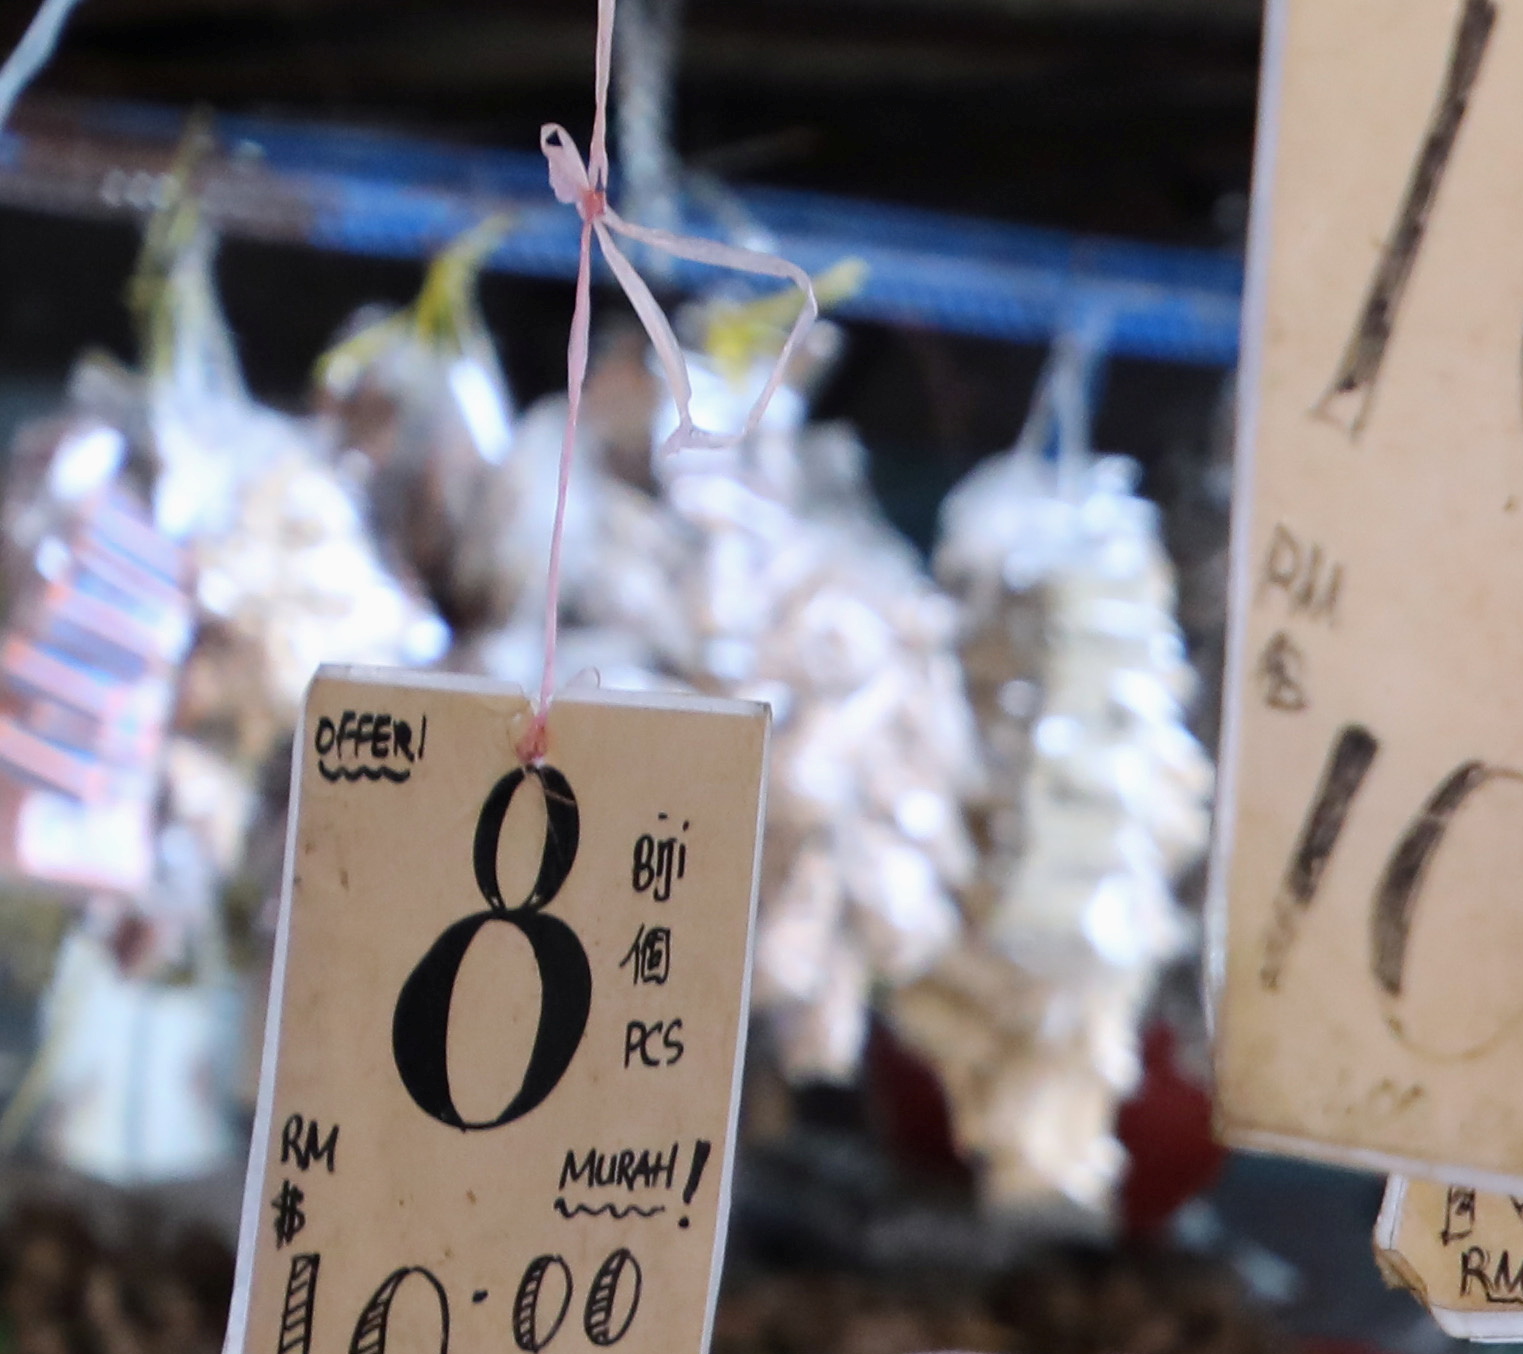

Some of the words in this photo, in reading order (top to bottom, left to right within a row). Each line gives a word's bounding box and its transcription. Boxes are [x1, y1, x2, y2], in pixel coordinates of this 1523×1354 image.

[315, 710, 427, 762] OFFER!
[392, 762, 592, 1130] 8
[624, 1017, 685, 1069] PCS
[280, 1113, 340, 1173] RM
[271, 1178, 305, 1250] $
